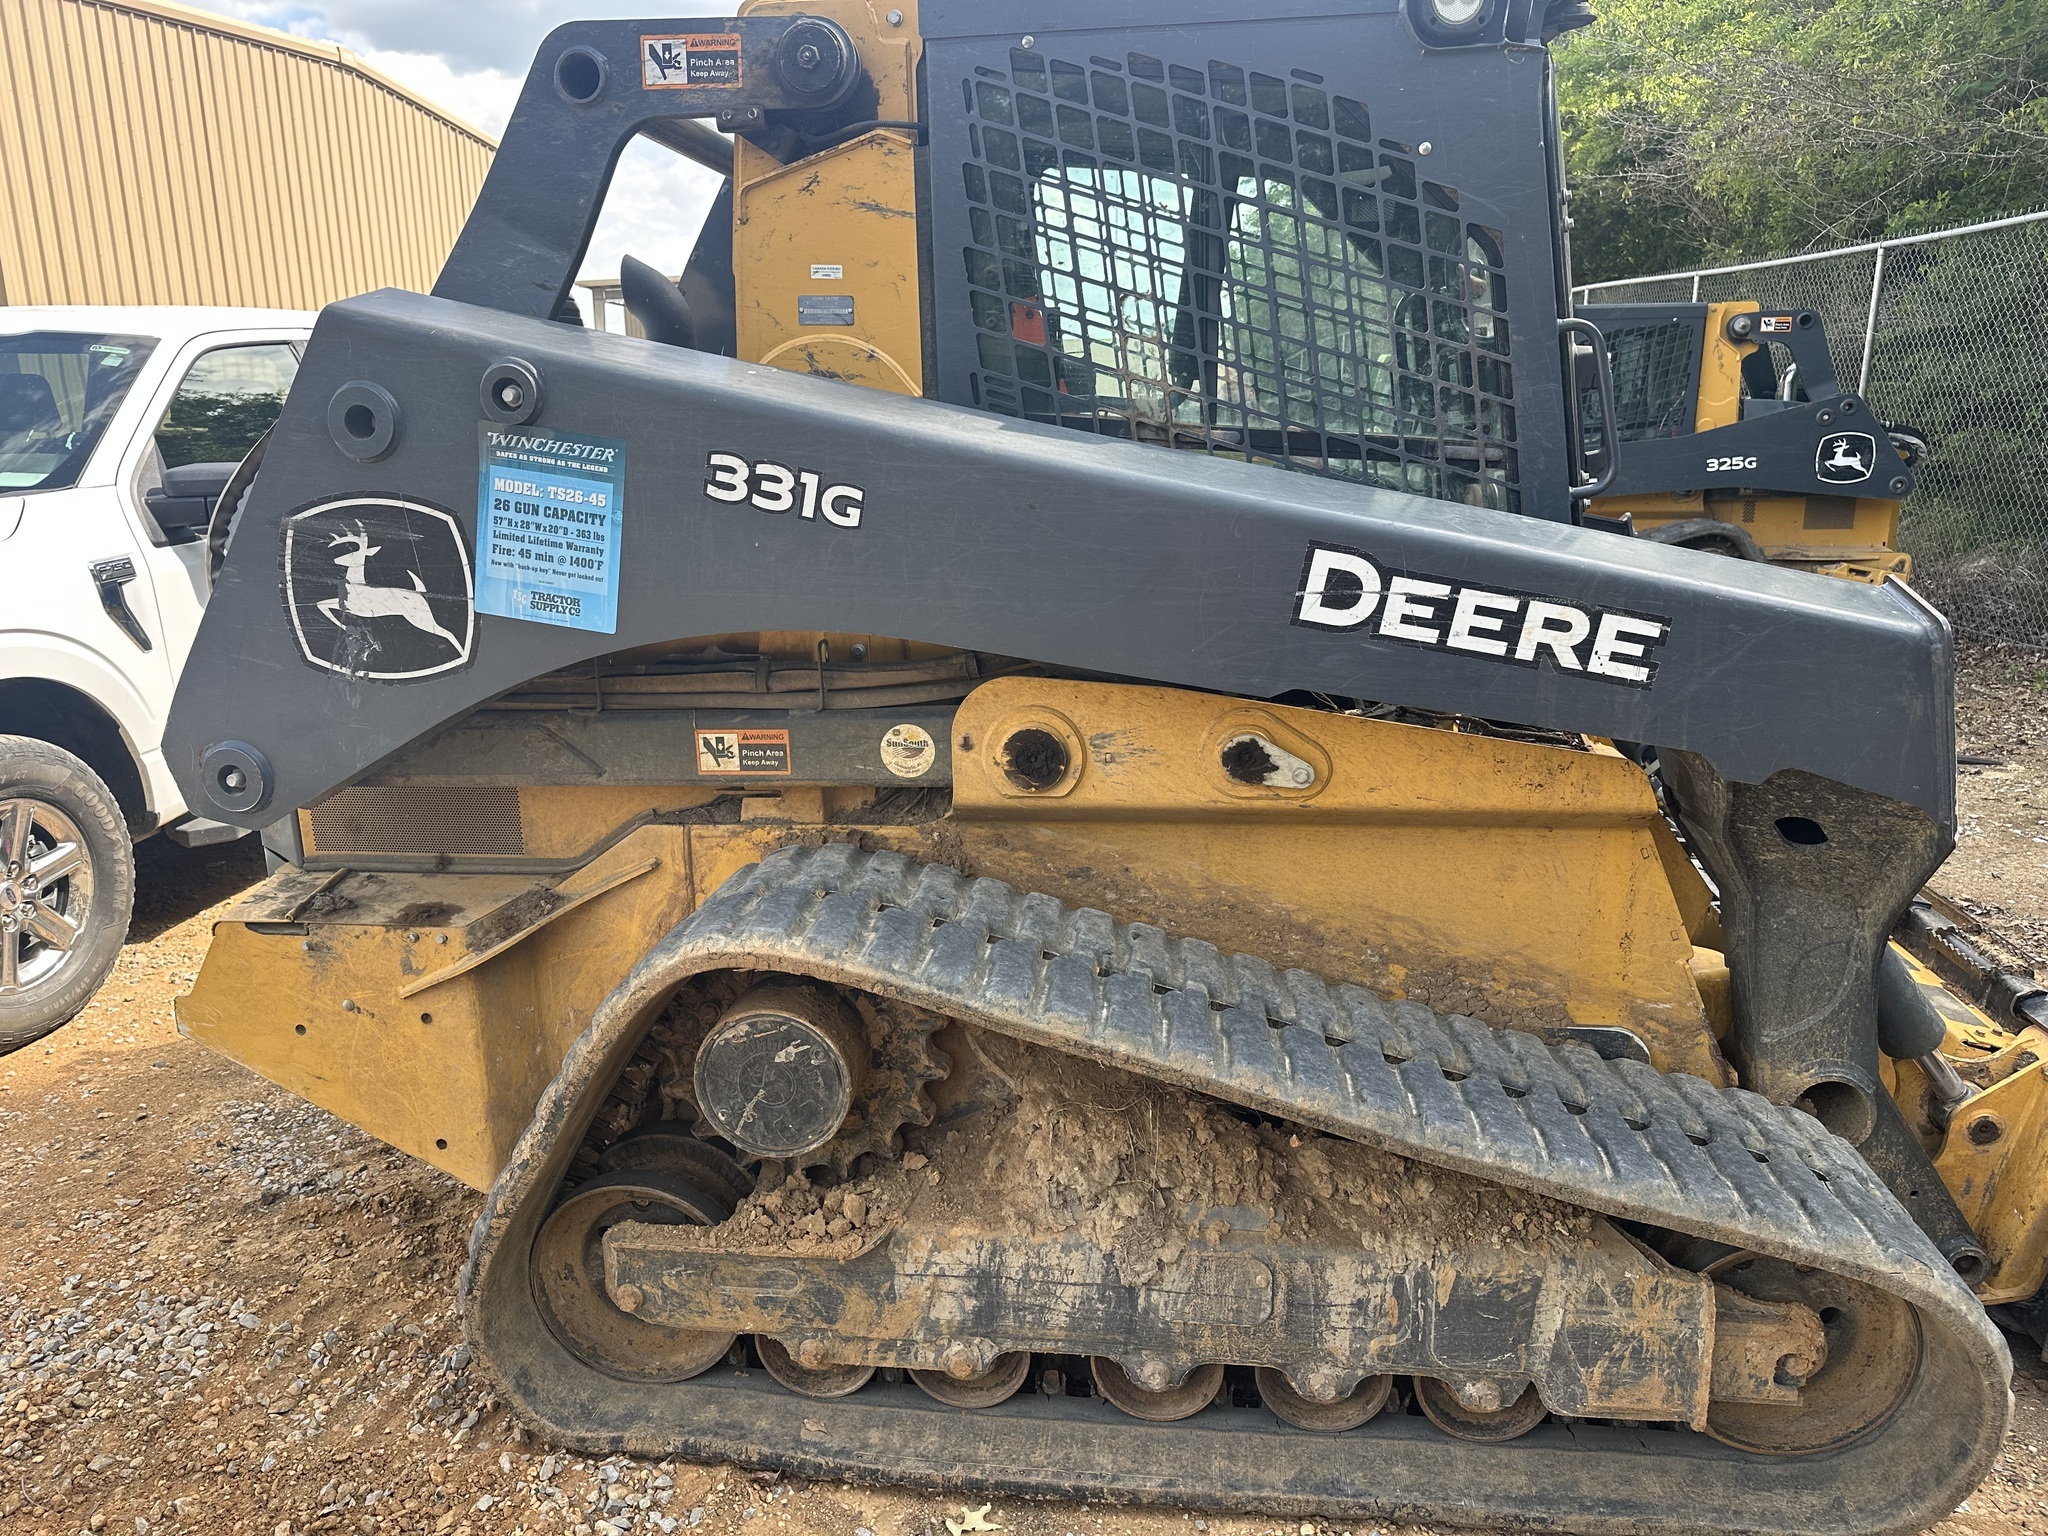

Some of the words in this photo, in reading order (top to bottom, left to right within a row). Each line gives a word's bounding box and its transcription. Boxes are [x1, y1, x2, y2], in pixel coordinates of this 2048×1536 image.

[698, 39, 735, 47] WARNING
[690, 58, 713, 67] Pinch
[716, 58, 735, 66] Area
[690, 70, 709, 78] Keep
[710, 70, 729, 78] Away
[487, 432, 615, 462] WINCHESTER
[496, 450, 517, 459] SAFES
[518, 453, 528, 461] AS
[529, 456, 555, 465] STRONG
[567, 461, 580, 469] THE
[582, 464, 608, 473] LEGEND
[1706, 456, 1757, 472] 325G
[494, 478, 544, 498] MODEL:
[548, 486, 607, 508] TS26-45
[706, 453, 864, 527] 331G
[493, 498, 511, 512] 26
[515, 502, 539, 517] GUN
[543, 506, 607, 527] CAPACITY
[493, 530, 525, 543] Limited
[528, 535, 563, 549] Lifetime
[566, 541, 604, 557] Warranty
[576, 529, 591, 540] 363
[593, 532, 605, 542] lbs
[492, 544, 515, 557] Fire:
[518, 548, 532, 559] 45
[535, 551, 554, 563] min
[557, 555, 566, 566] @
[552, 569, 567, 577] Never
[577, 573, 594, 581] locked
[512, 589, 527, 604] TSC
[531, 590, 581, 607] TRACTOR
[530, 601, 568, 615] SUPPLY
[1298, 548, 1663, 682] DEERE
[886, 738, 929, 748] SunSouth
[742, 749, 764, 757] Pinch
[760, 759, 779, 767] Away
[74, 781, 128, 910] GOODYEAR
